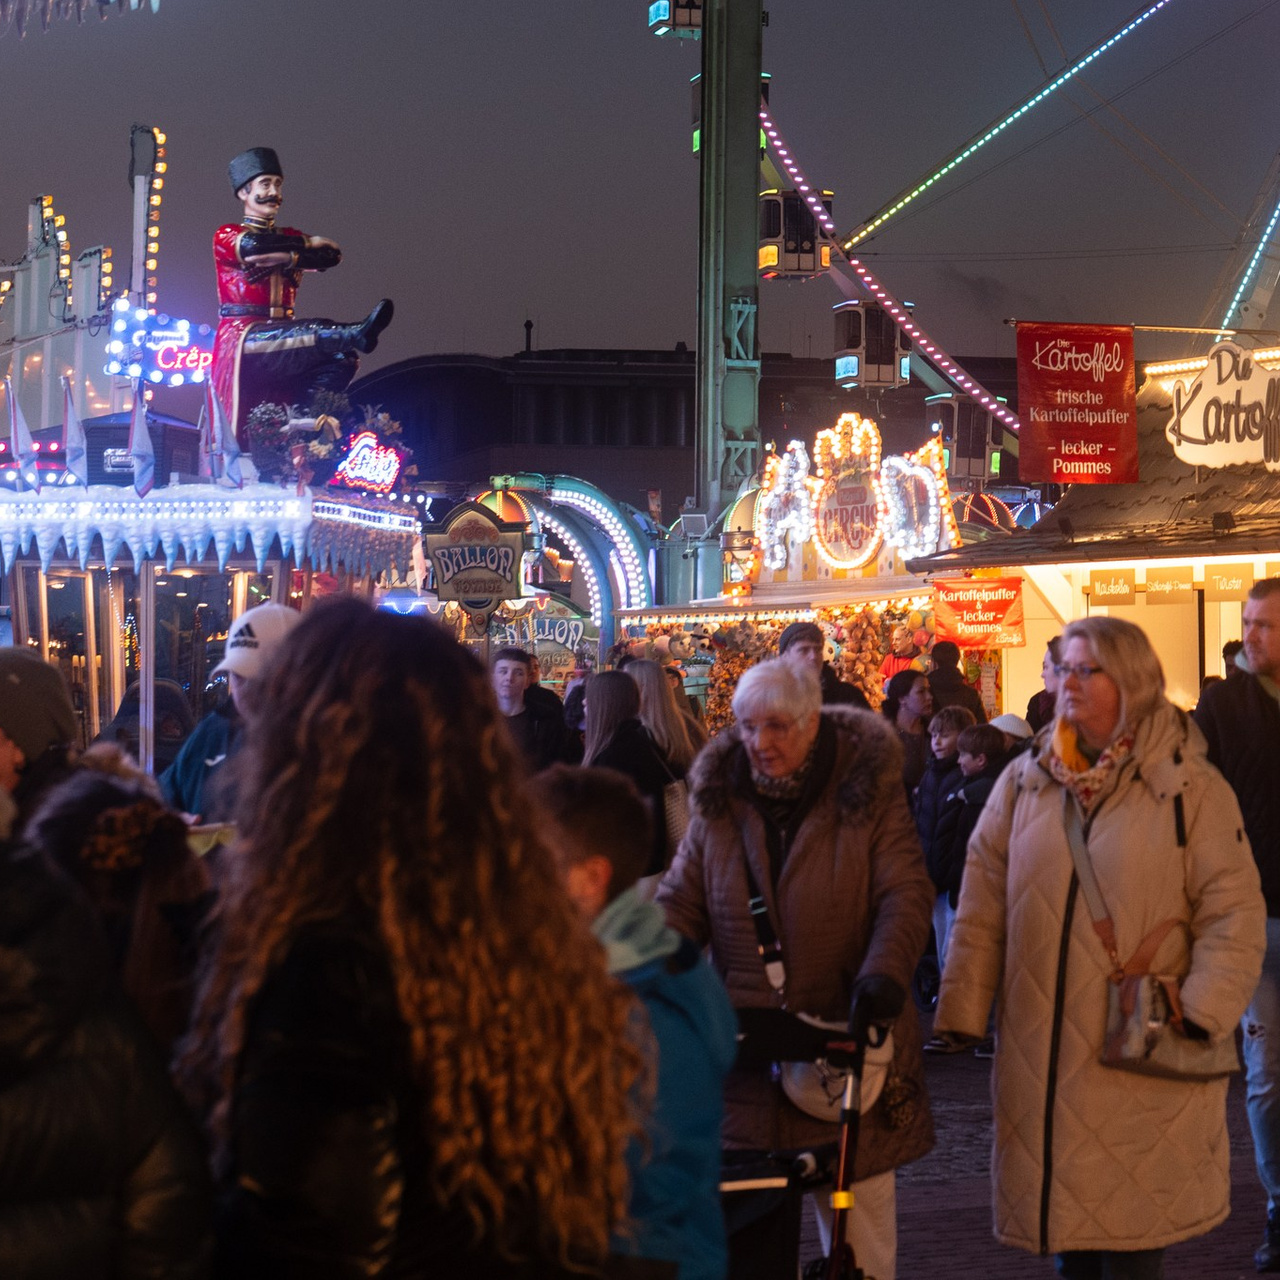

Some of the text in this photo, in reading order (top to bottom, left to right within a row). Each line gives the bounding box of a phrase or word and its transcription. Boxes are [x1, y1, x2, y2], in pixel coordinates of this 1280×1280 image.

[1032, 341, 1124, 382] Kartoffel
[1211, 348, 1253, 385] Die
[1057, 389, 1103, 405] frische
[1030, 407, 1130, 426] Kartoffelpuffer
[1061, 439, 1103, 455] lecker
[1053, 459, 1112, 475] Pommes
[435, 545, 514, 583] BALLON
[940, 588, 1017, 602] Kartoffelpuffer
[975, 601, 982, 609] &
[963, 610, 996, 622] lecker
[957, 622, 1002, 633] Pommes
